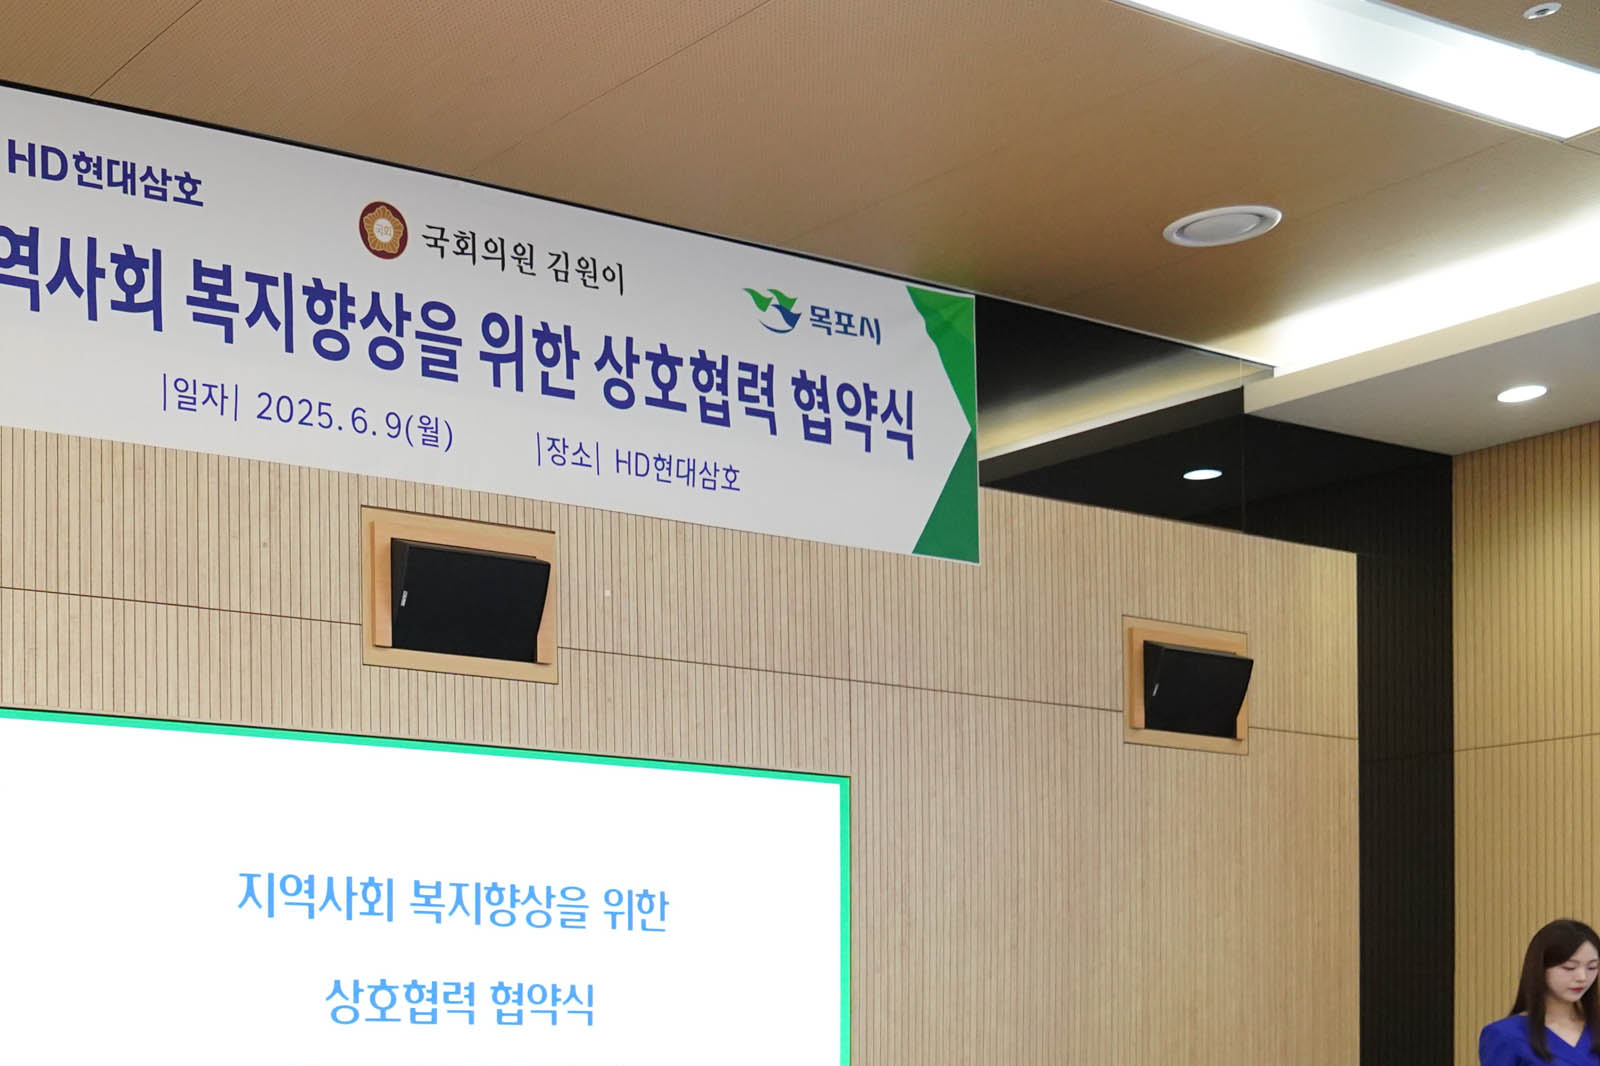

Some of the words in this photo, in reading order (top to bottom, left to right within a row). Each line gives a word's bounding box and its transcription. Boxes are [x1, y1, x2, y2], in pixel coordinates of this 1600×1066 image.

[7, 138, 204, 208] HD현대삼호
[421, 224, 537, 277] 국회의원
[547, 250, 624, 297] 김원이
[809, 304, 882, 346] 목포시
[185, 258, 463, 383] 복지향상을
[479, 311, 581, 401] 위한
[593, 335, 778, 437] 상호협력
[790, 368, 915, 461] 협약식
[615, 448, 741, 492] HD현대삼호
[237, 871, 394, 923] 지역사회
[409, 879, 590, 930] 복지향상을
[602, 888, 670, 933] 위한
[325, 978, 475, 1026] 상호협력
[489, 980, 594, 1027] 협약식
